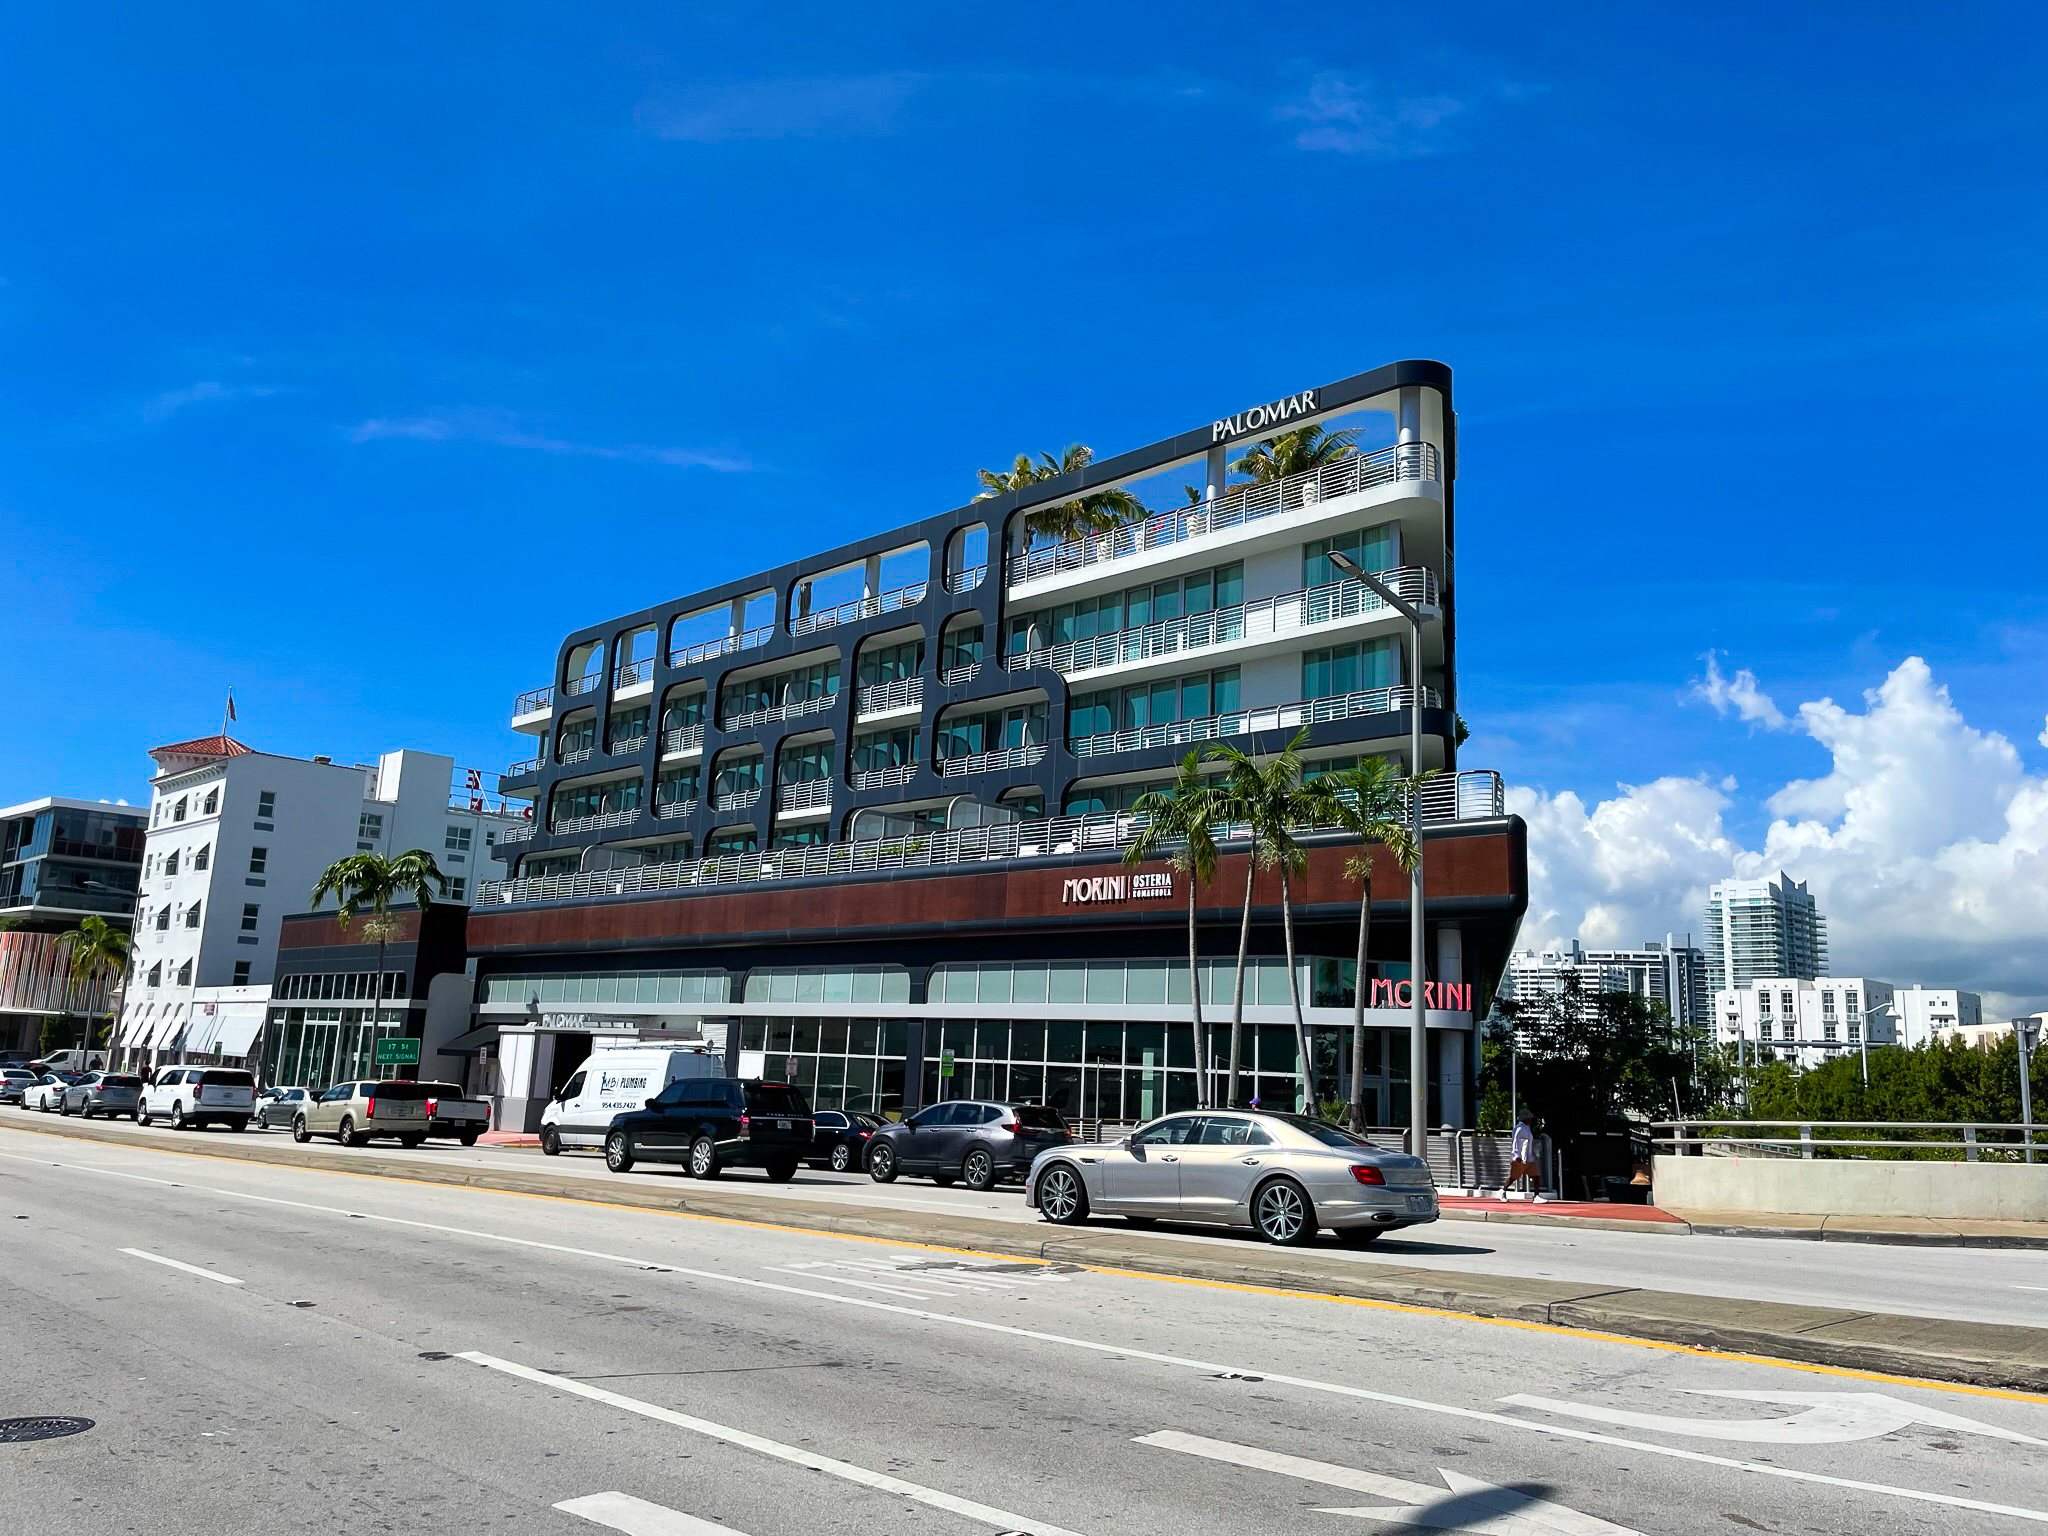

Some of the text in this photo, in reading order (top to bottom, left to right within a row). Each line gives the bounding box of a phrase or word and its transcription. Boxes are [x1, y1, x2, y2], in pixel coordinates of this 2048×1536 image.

[1212, 390, 1316, 442] PALOMAR
[1062, 876, 1126, 903] MORINI
[1133, 873, 1172, 888] OSTERIA
[1370, 979, 1471, 1010] MORINI
[620, 1077, 647, 1089] PLUMBING
